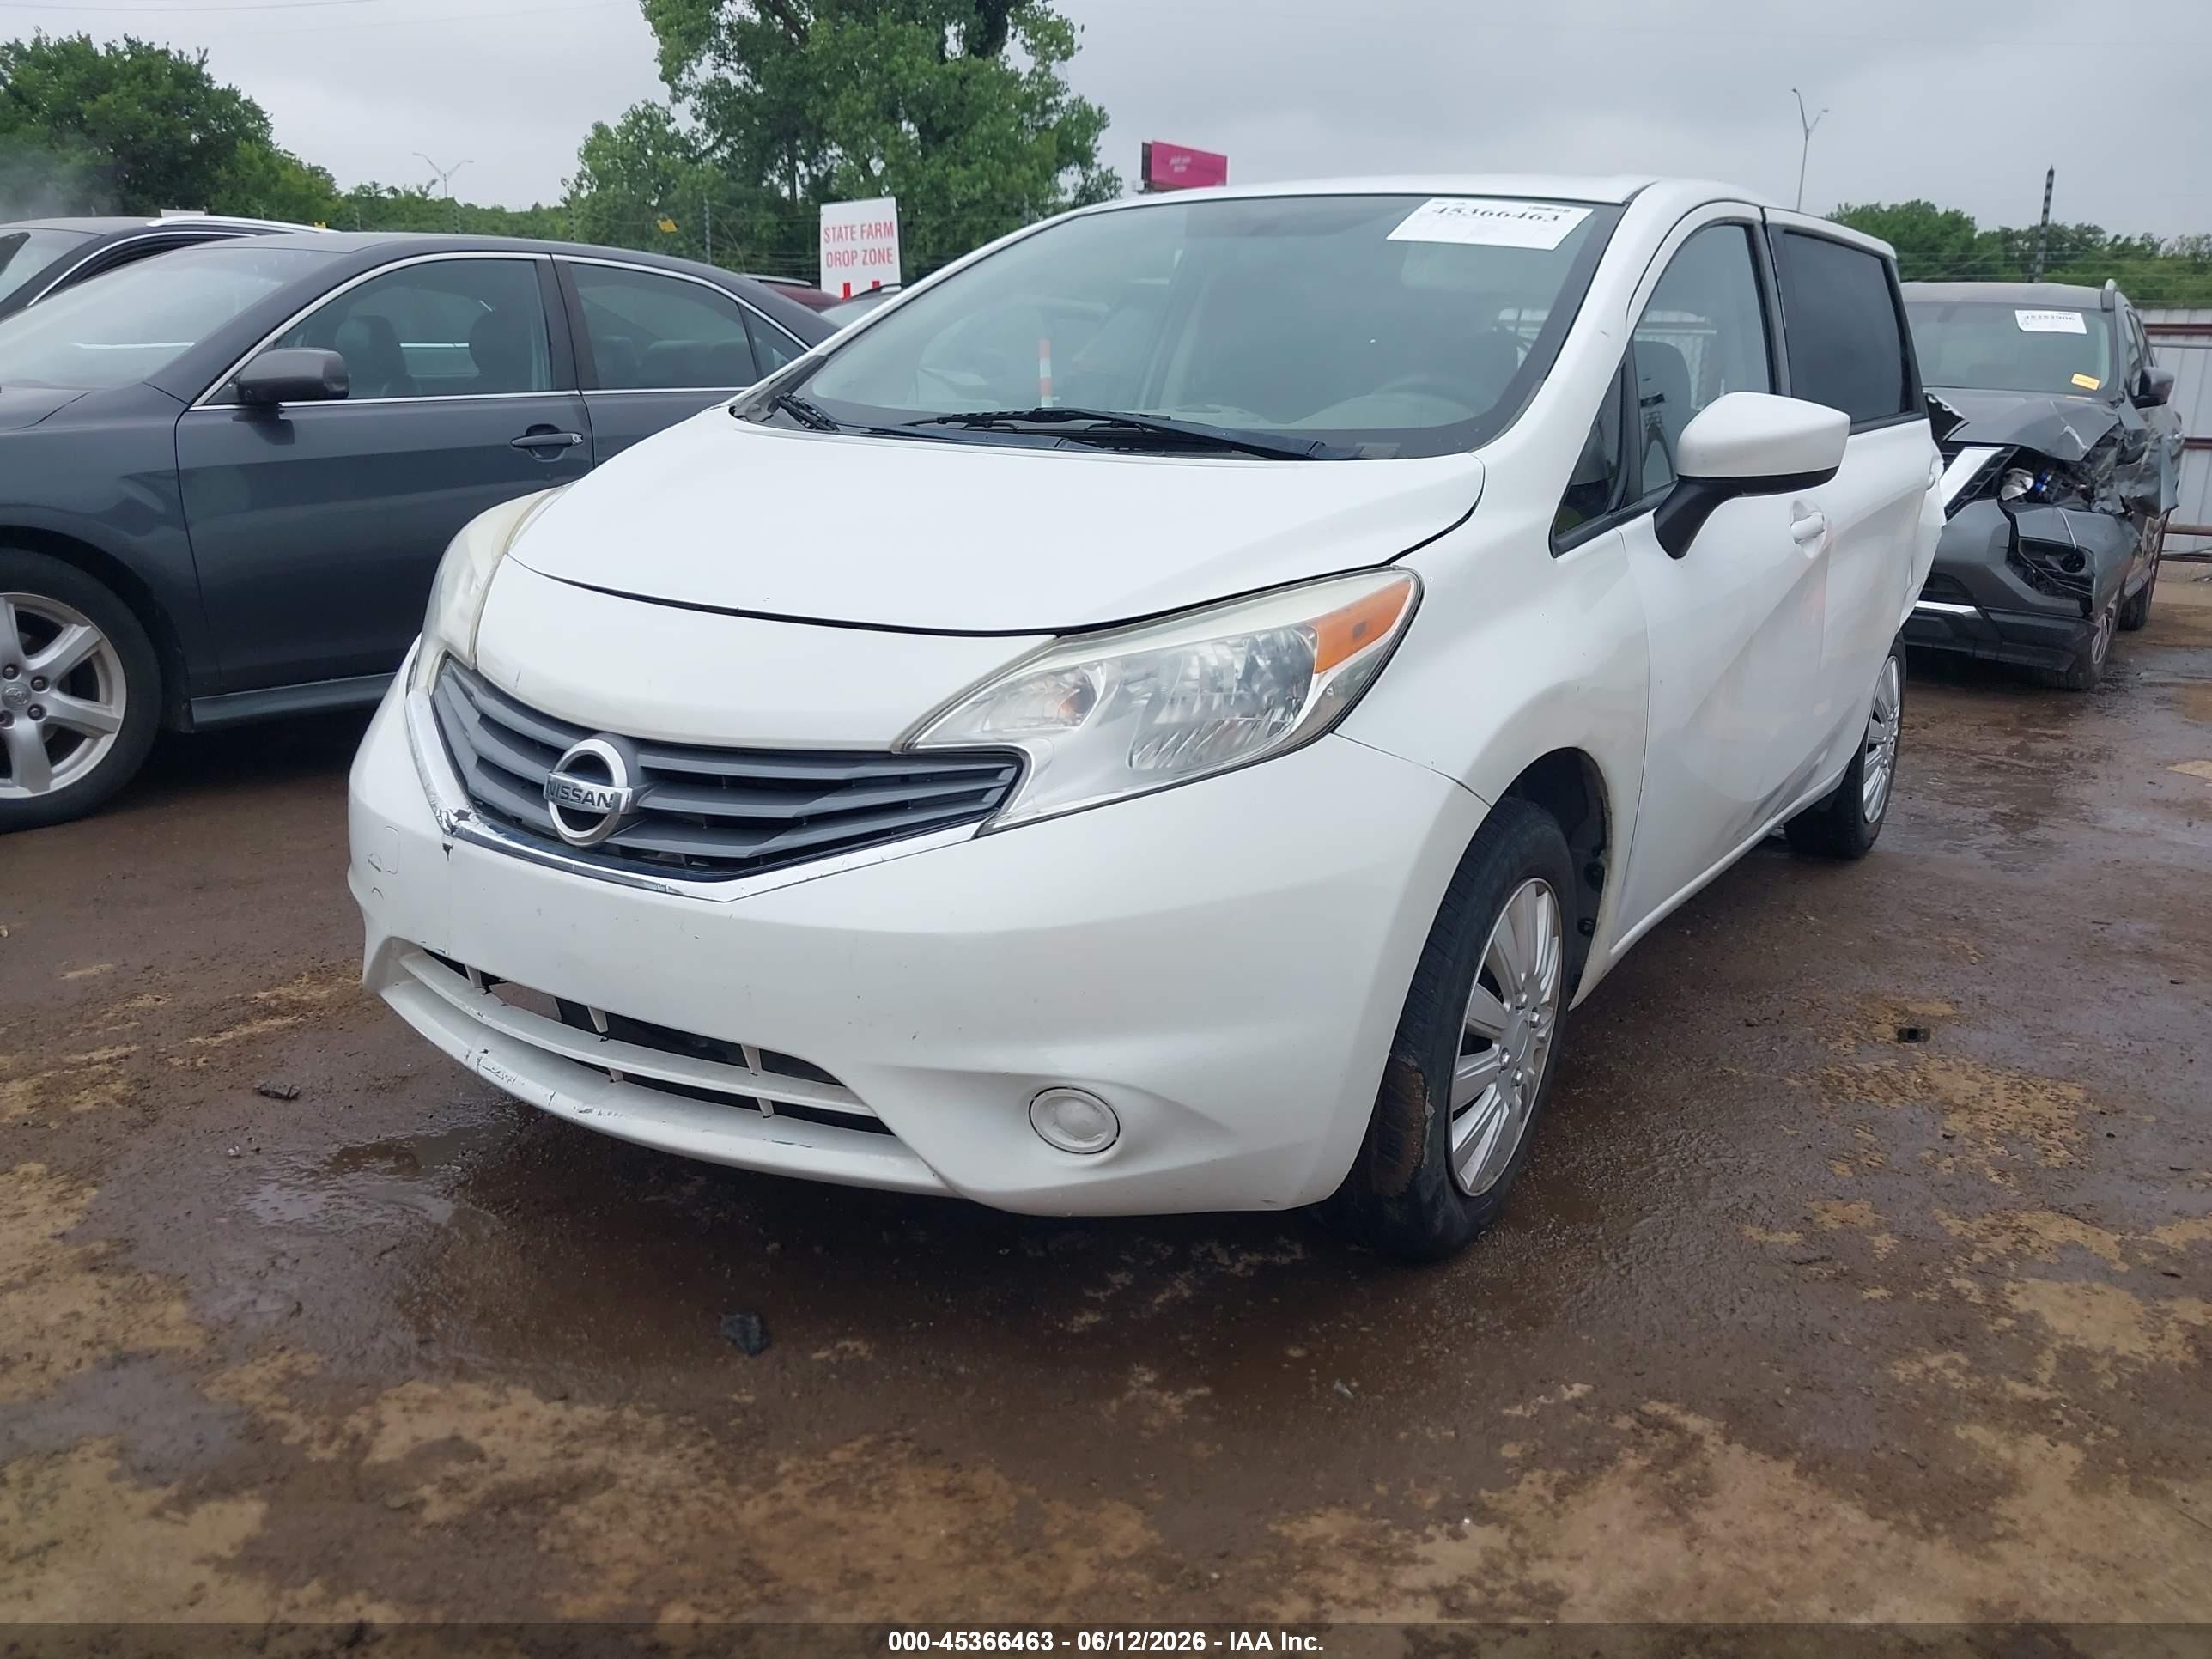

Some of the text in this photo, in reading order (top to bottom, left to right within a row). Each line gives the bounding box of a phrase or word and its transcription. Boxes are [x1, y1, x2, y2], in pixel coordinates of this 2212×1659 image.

[1432, 205, 1560, 222] 45366463
[824, 222, 894, 243] STATE FARM
[826, 247, 893, 268] DROP ZONE
[548, 780, 614, 808] NISSAN
